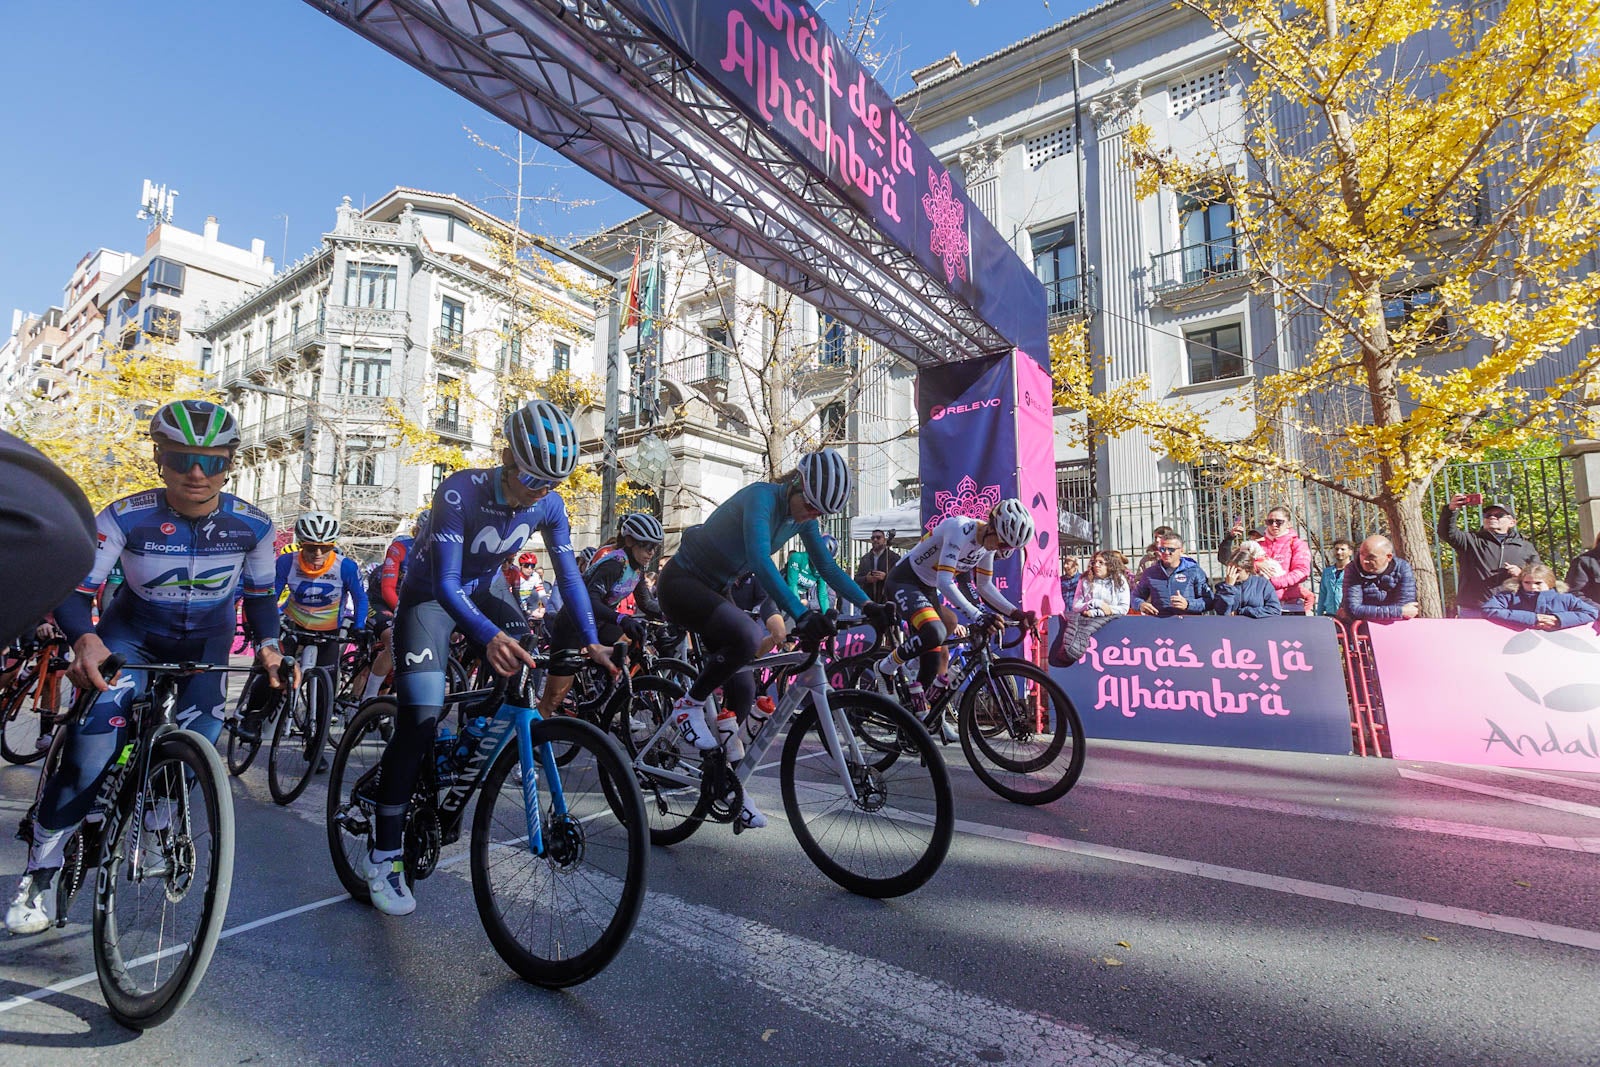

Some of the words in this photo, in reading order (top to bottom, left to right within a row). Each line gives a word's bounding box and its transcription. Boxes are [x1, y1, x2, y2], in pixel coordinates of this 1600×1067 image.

[946, 398, 1001, 415] RELEVO
[144, 541, 188, 554] Ekopak
[914, 545, 939, 566] CADEX
[442, 719, 511, 812] CANYON
